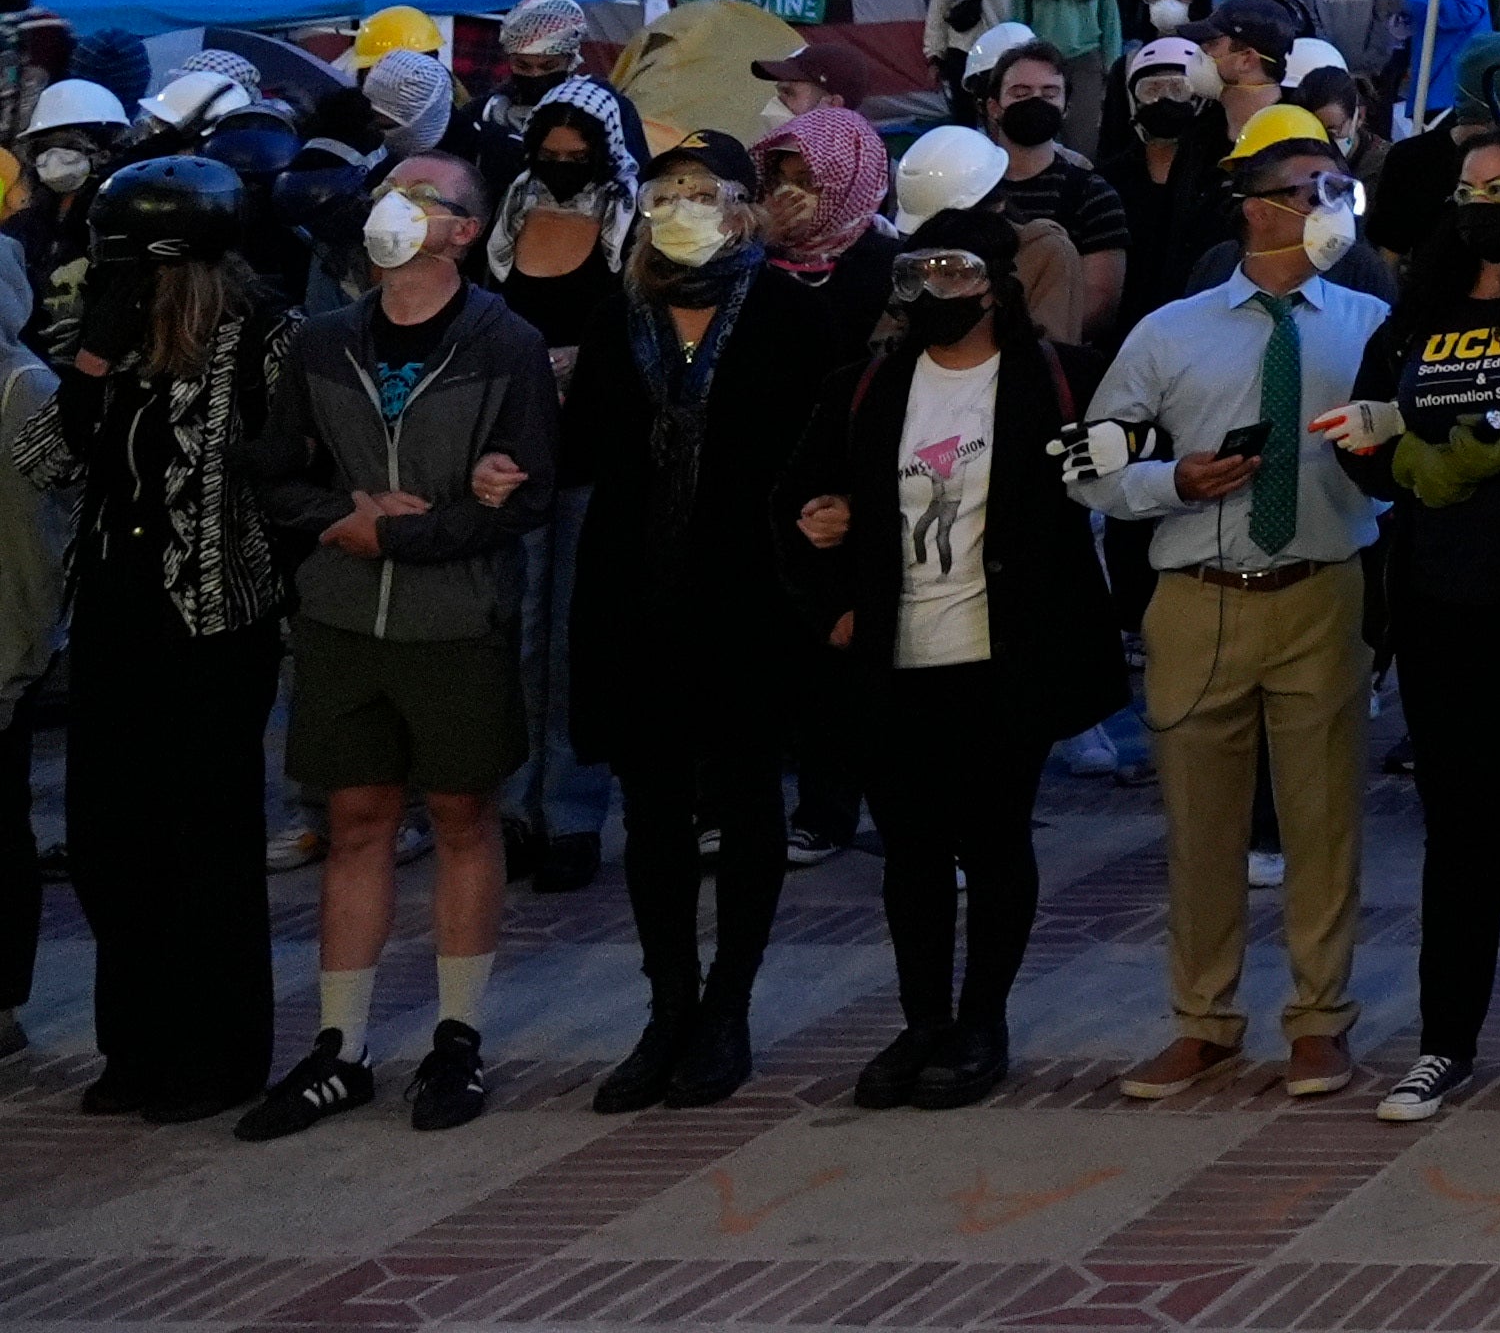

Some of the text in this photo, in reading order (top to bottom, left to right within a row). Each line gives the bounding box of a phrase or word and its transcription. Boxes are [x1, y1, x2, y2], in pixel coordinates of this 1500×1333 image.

[1417, 362, 1465, 376] School
[1466, 359, 1482, 371] of
[1475, 372, 1487, 385] &
[1415, 388, 1494, 408] Information
